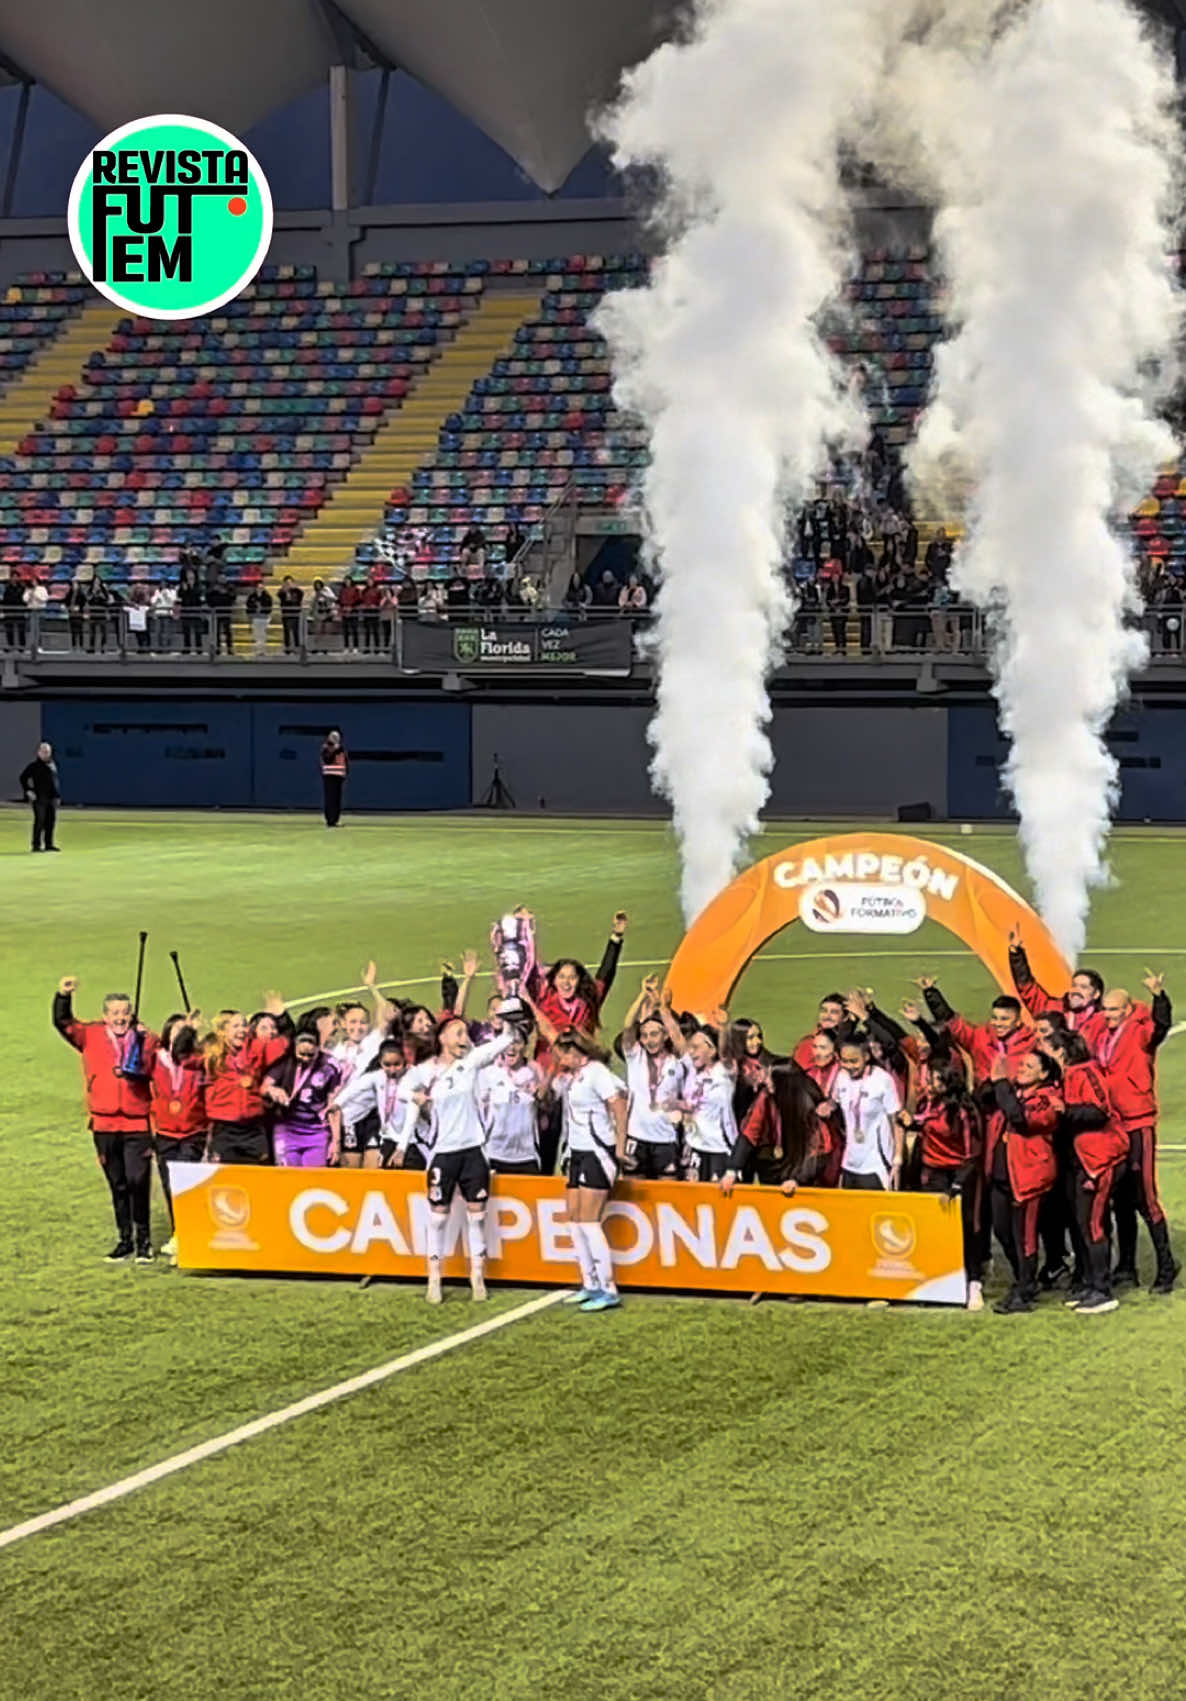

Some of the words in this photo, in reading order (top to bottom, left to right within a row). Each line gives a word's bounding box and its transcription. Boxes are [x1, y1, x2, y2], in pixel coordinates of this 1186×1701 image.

[480, 628, 497, 641] La
[541, 628, 569, 638] CADA
[480, 641, 530, 654] Florida
[541, 640, 561, 650] VEZ
[773, 853, 959, 901] CAMPEÓN
[431, 1167, 442, 1185] 3
[288, 1187, 833, 1275] CAMPEONAS
